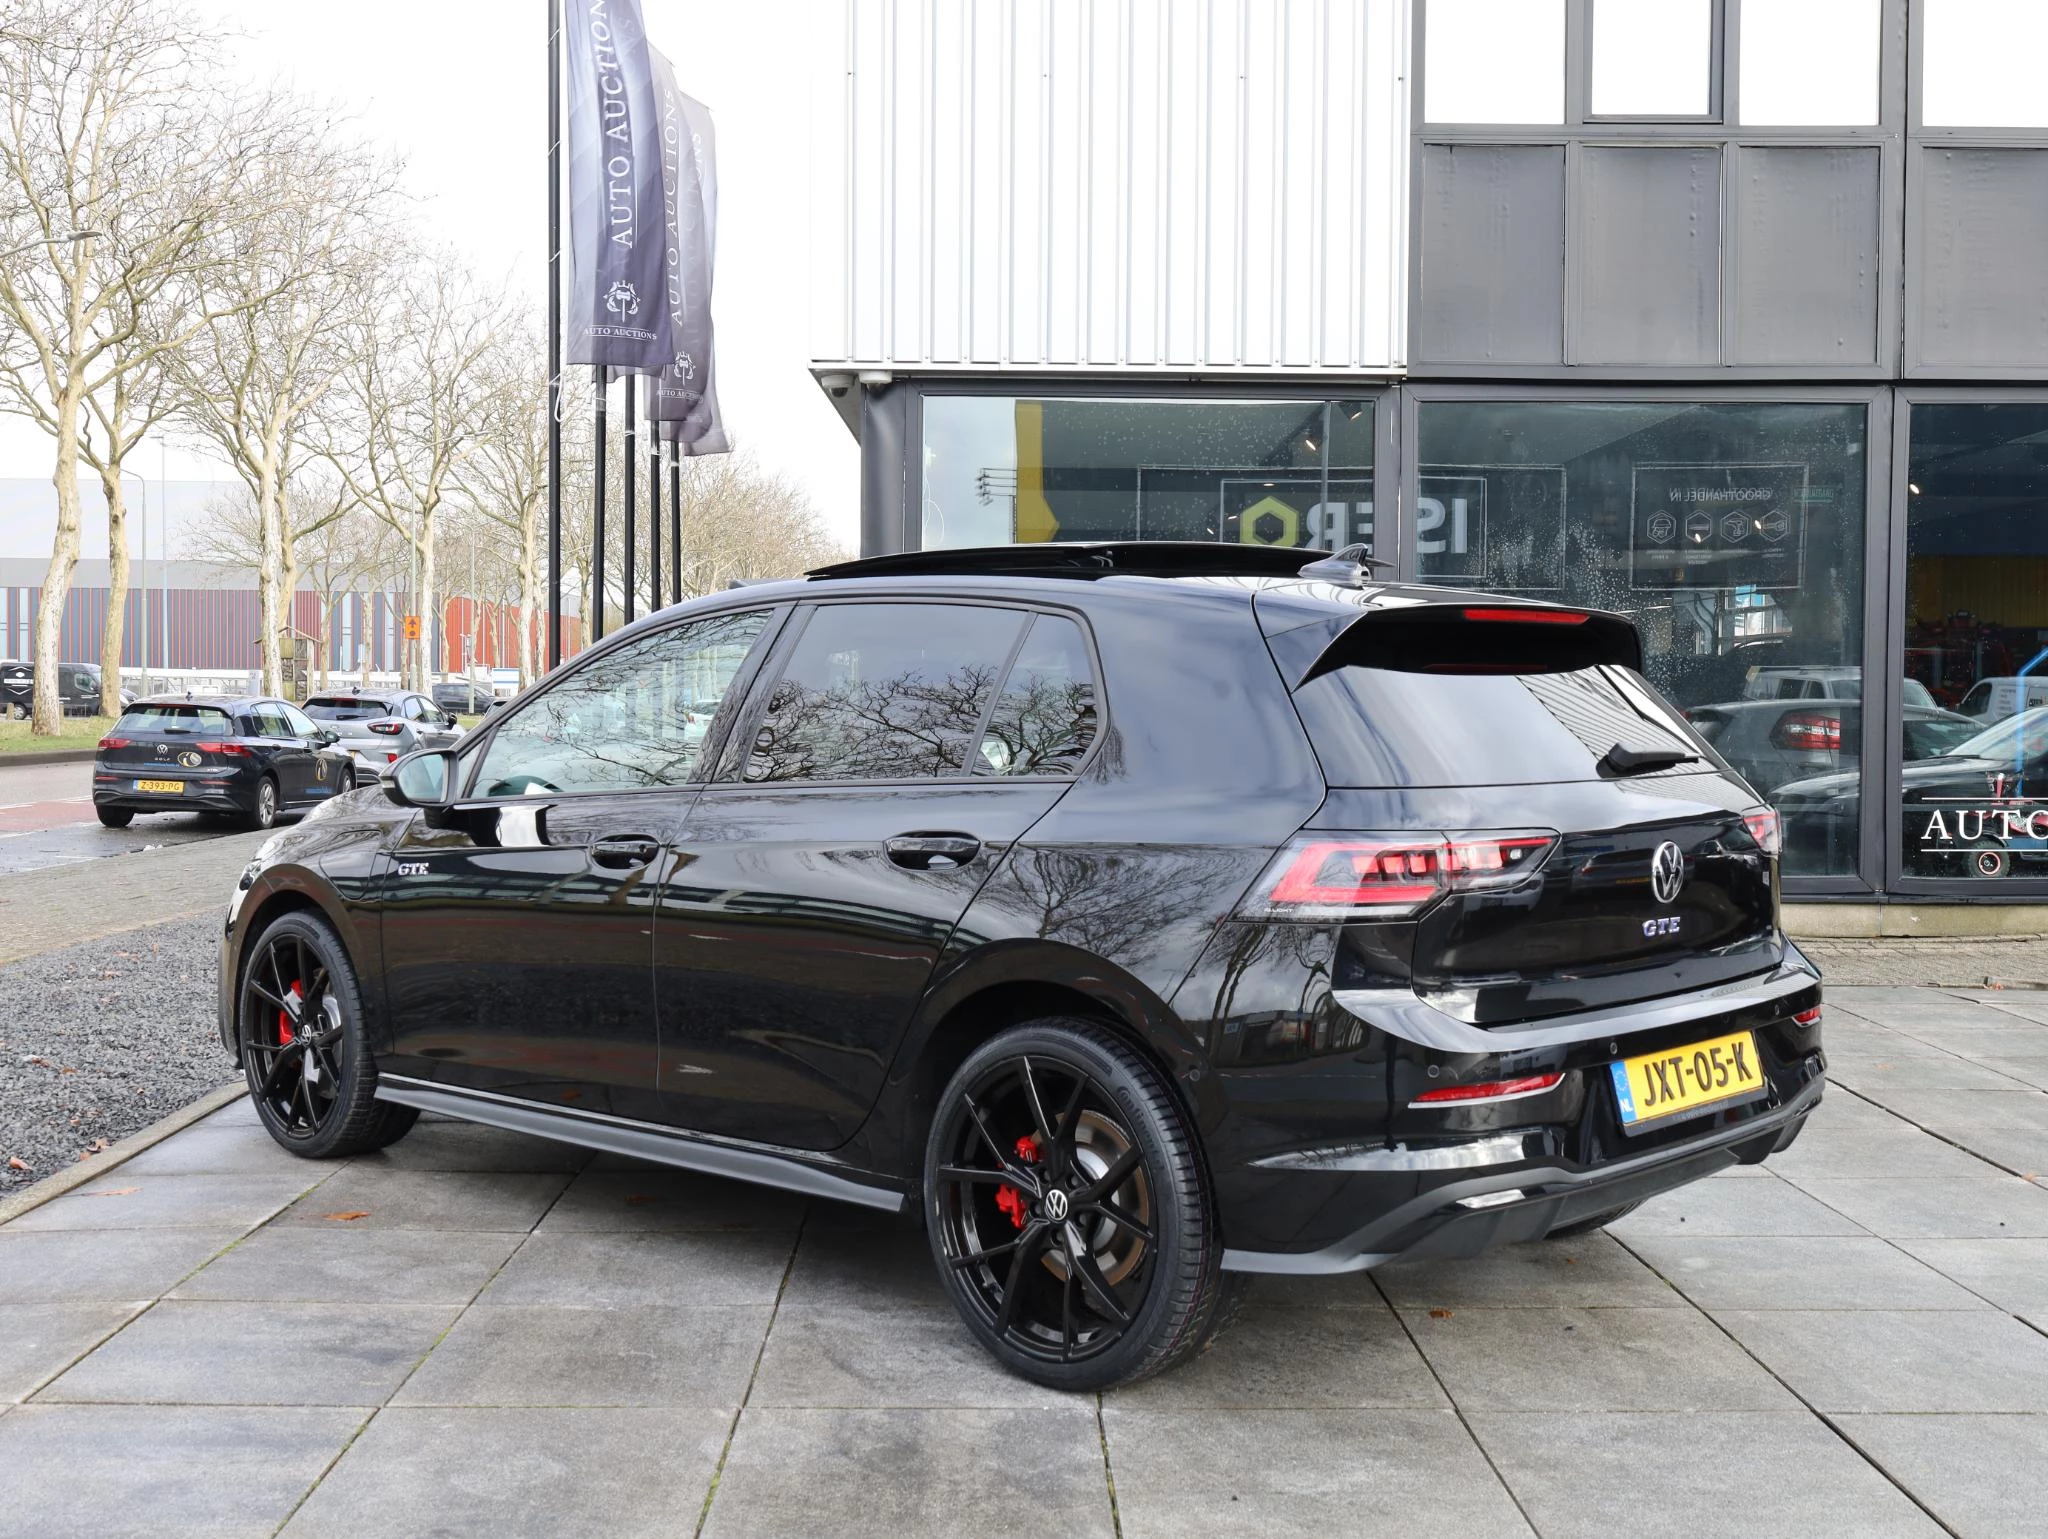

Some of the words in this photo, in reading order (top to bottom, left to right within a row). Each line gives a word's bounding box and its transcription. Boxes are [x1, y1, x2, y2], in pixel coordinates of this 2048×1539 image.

[664, 89, 679, 238] AUCTIONS
[607, 156, 633, 249] AUTO
[666, 248, 684, 327] AUTO
[583, 327, 611, 336] AUTO
[613, 328, 658, 340] AUCTIONS
[141, 781, 180, 791] Z-393-PG
[398, 862, 429, 875] GTE
[1641, 916, 1681, 937] GTE
[1644, 1042, 1753, 1107] JXT-05-K
[1620, 1098, 1634, 1113] NL
